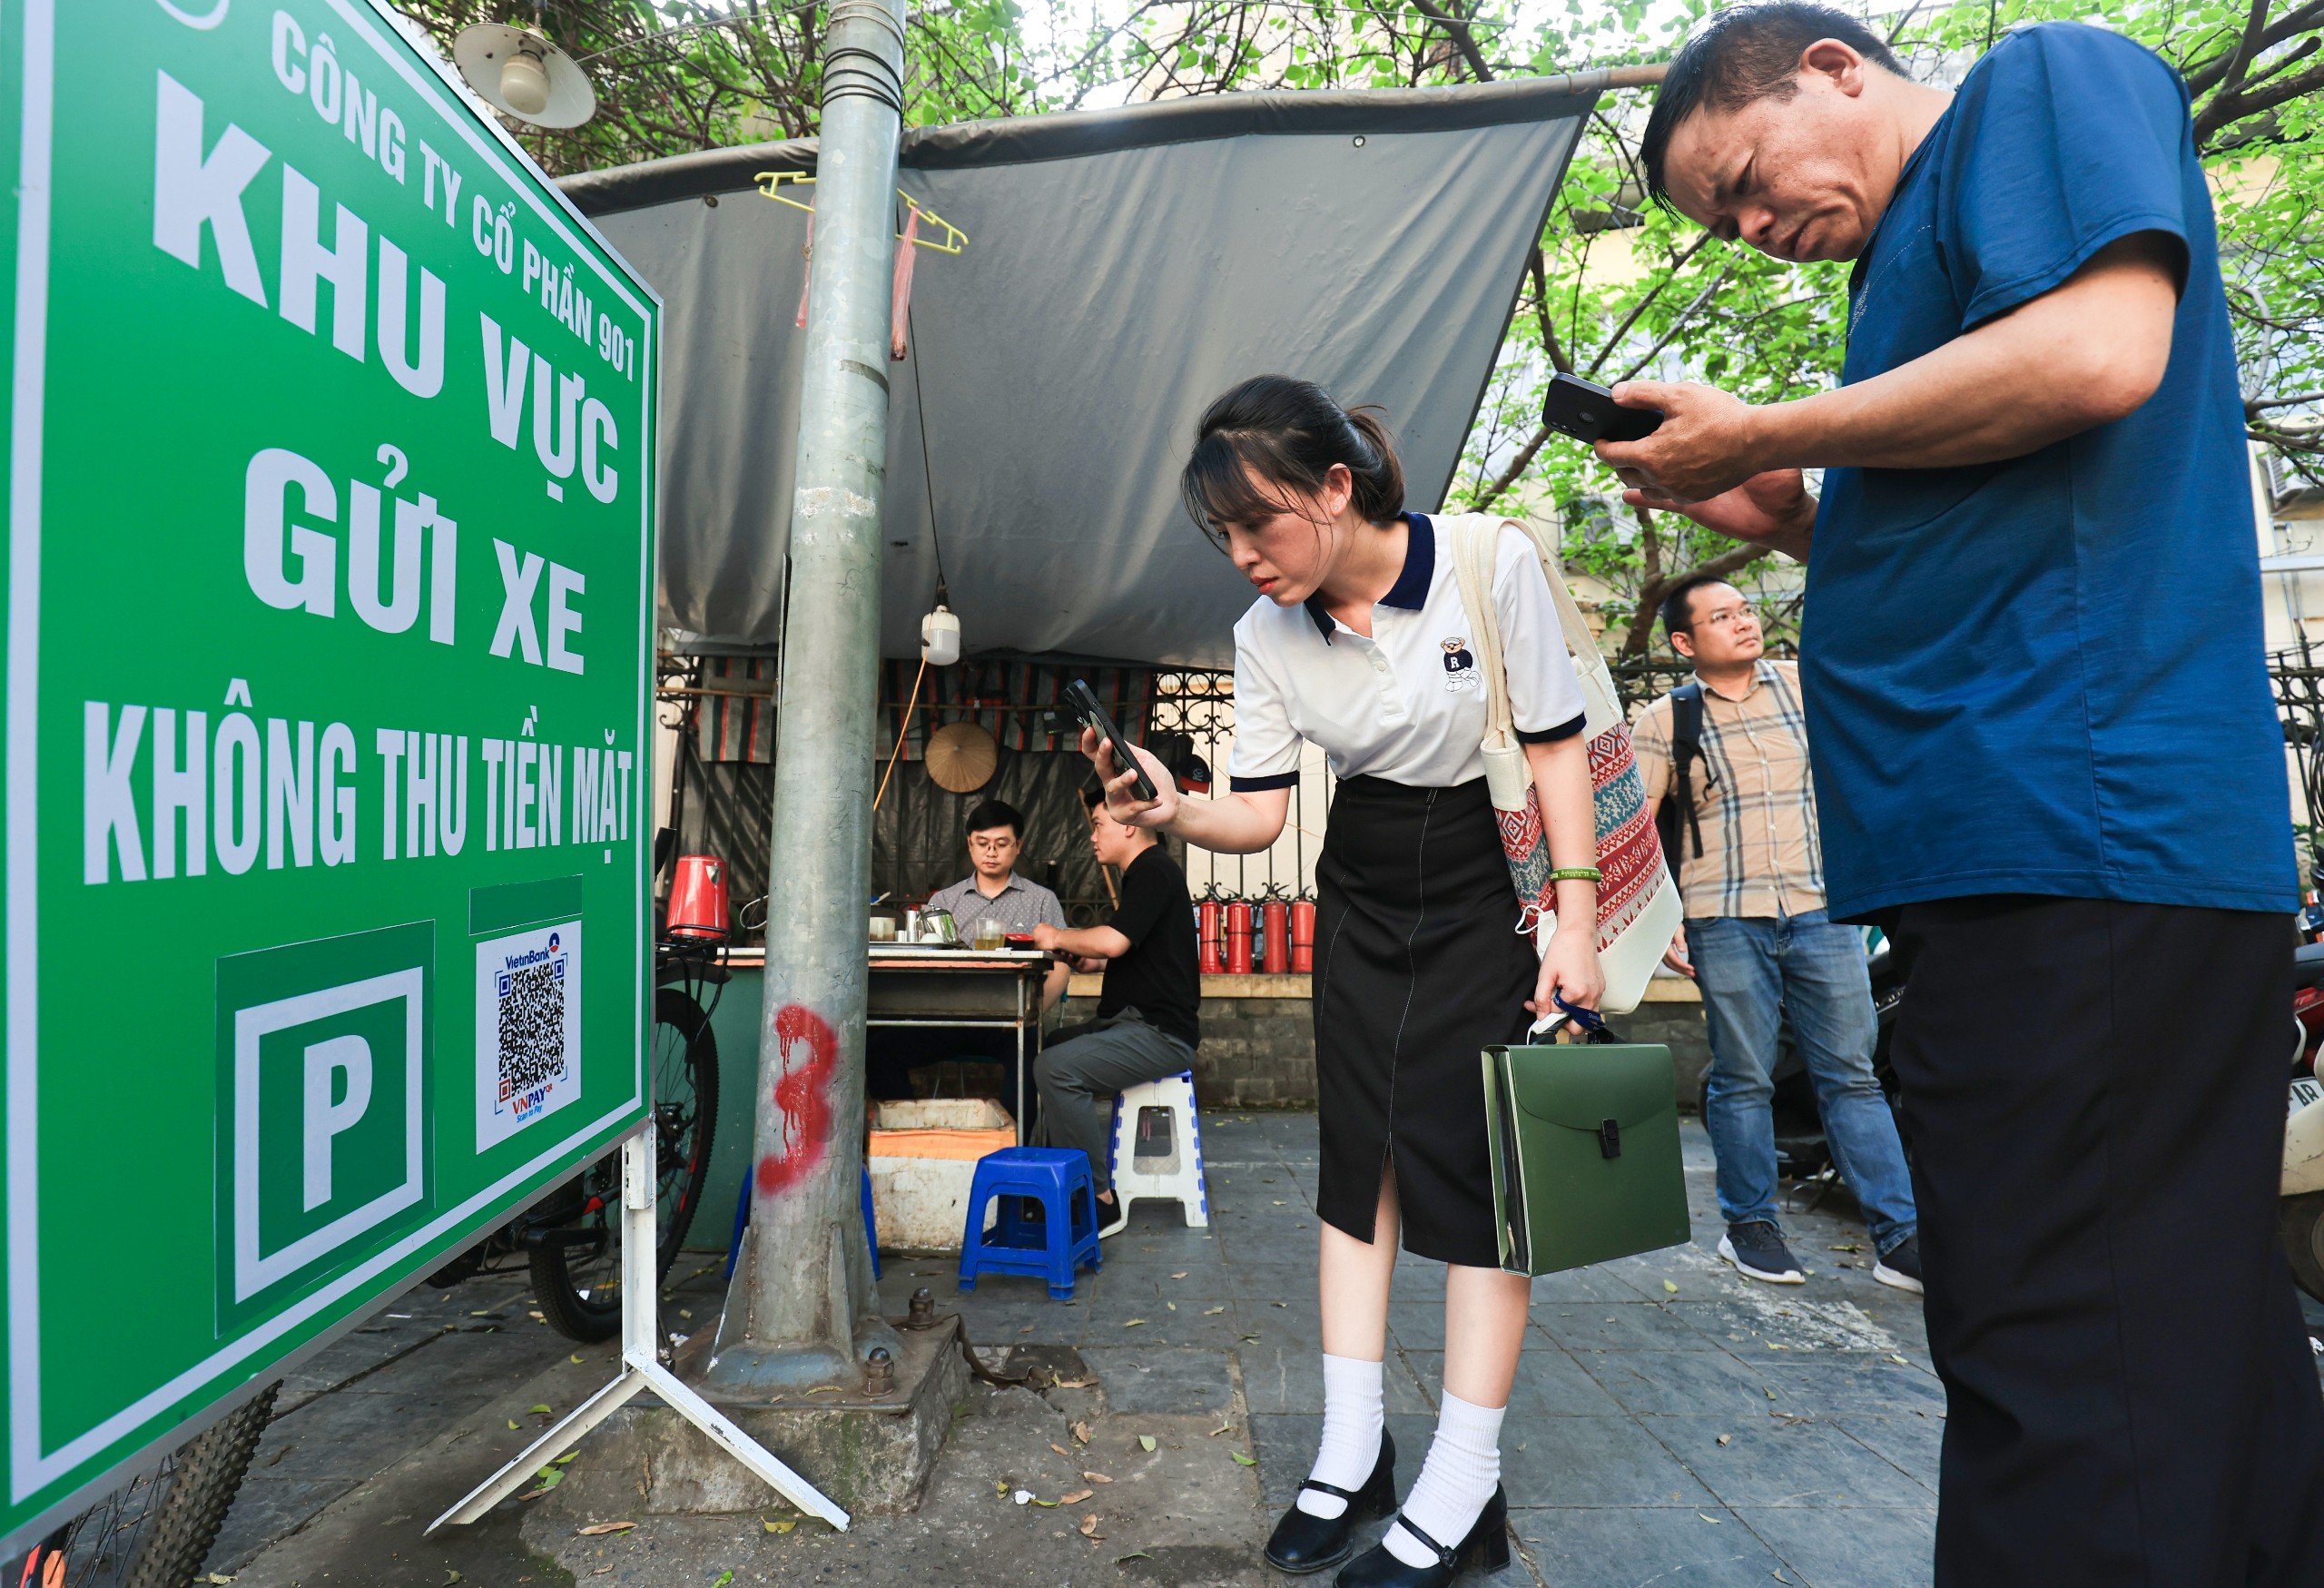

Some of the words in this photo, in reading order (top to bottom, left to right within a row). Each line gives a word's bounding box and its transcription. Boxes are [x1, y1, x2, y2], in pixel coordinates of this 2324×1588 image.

[153, 68, 446, 399] KHU
[480, 311, 618, 504] VỰC
[271, 9, 406, 185] CÔNG
[419, 138, 462, 228] TY
[472, 193, 517, 275] CỔ
[523, 237, 592, 347] PHẦN
[598, 320, 635, 381] 901
[243, 442, 458, 646] GỬI
[488, 538, 586, 676] XE
[84, 677, 357, 885] KHÔNG
[376, 728, 468, 861] THU
[482, 705, 562, 852] TIỀN
[572, 727, 632, 864] MẶT
[506, 947, 550, 970] VietinBank
[303, 1034, 373, 1213] P
